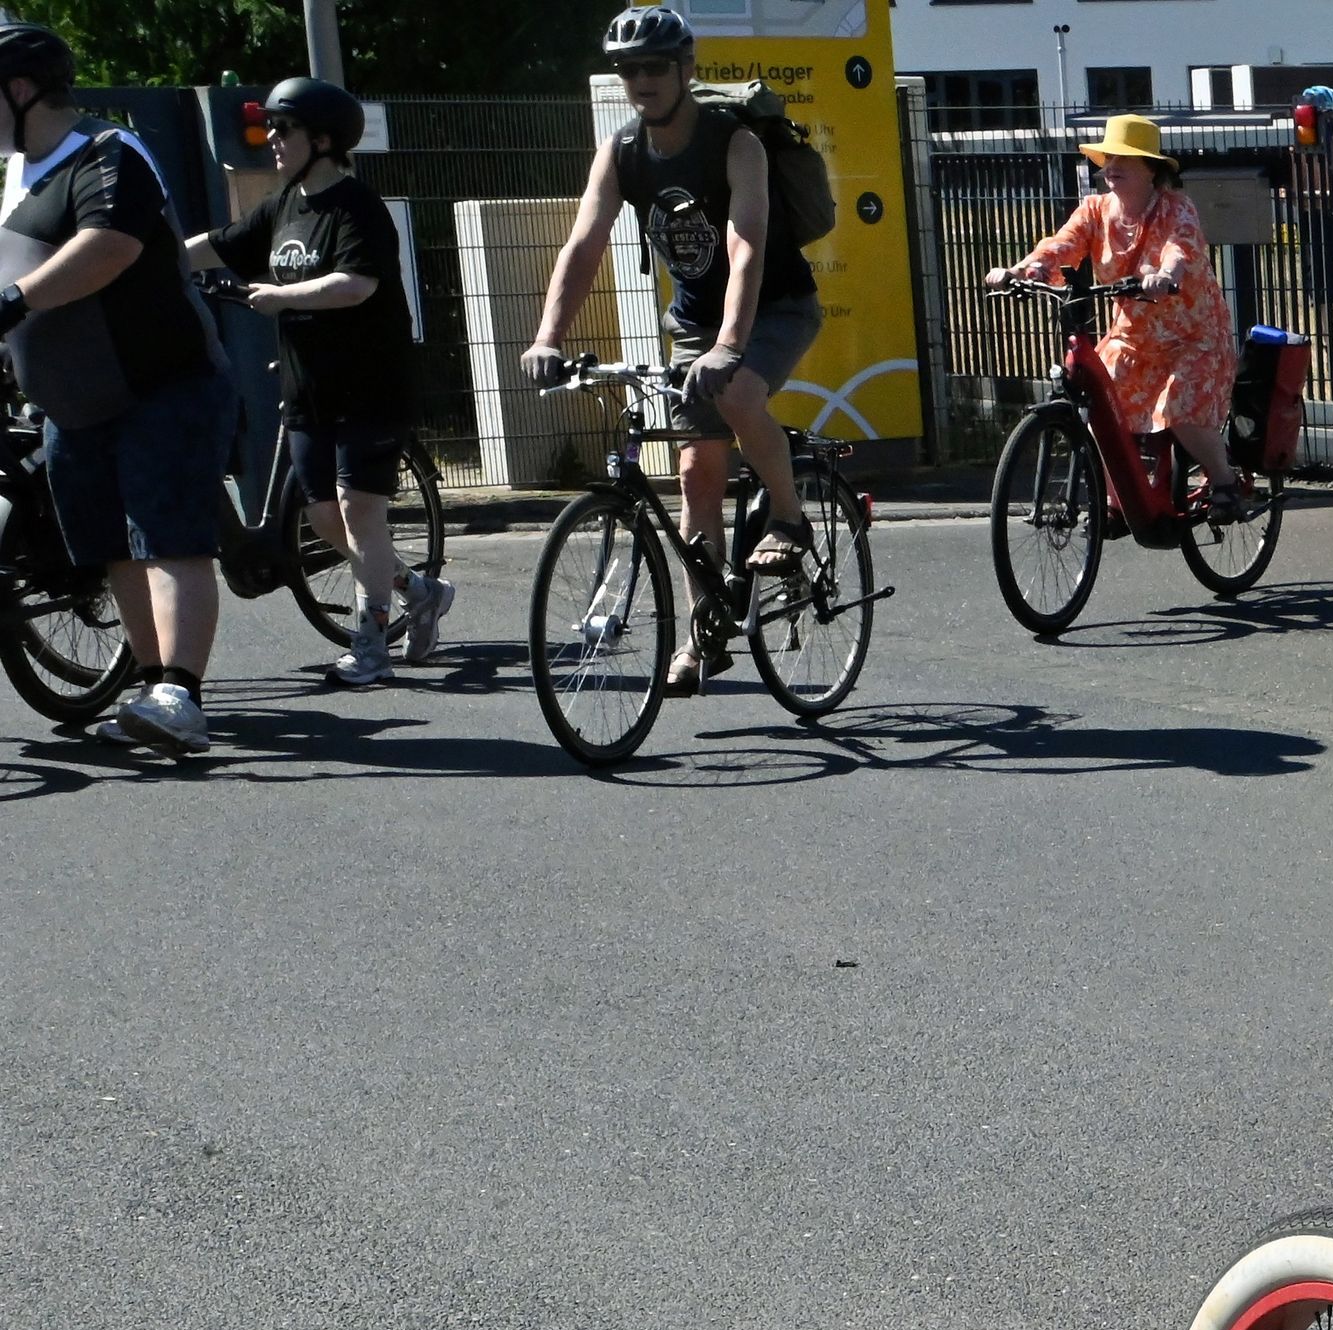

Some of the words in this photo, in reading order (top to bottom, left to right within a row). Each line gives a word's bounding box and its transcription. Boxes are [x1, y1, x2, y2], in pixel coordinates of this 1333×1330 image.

[696, 61, 814, 85] trieb/Lager
[289, 249, 320, 270] Rock
[827, 261, 848, 272] Uhr
[830, 305, 852, 318] Uhr
